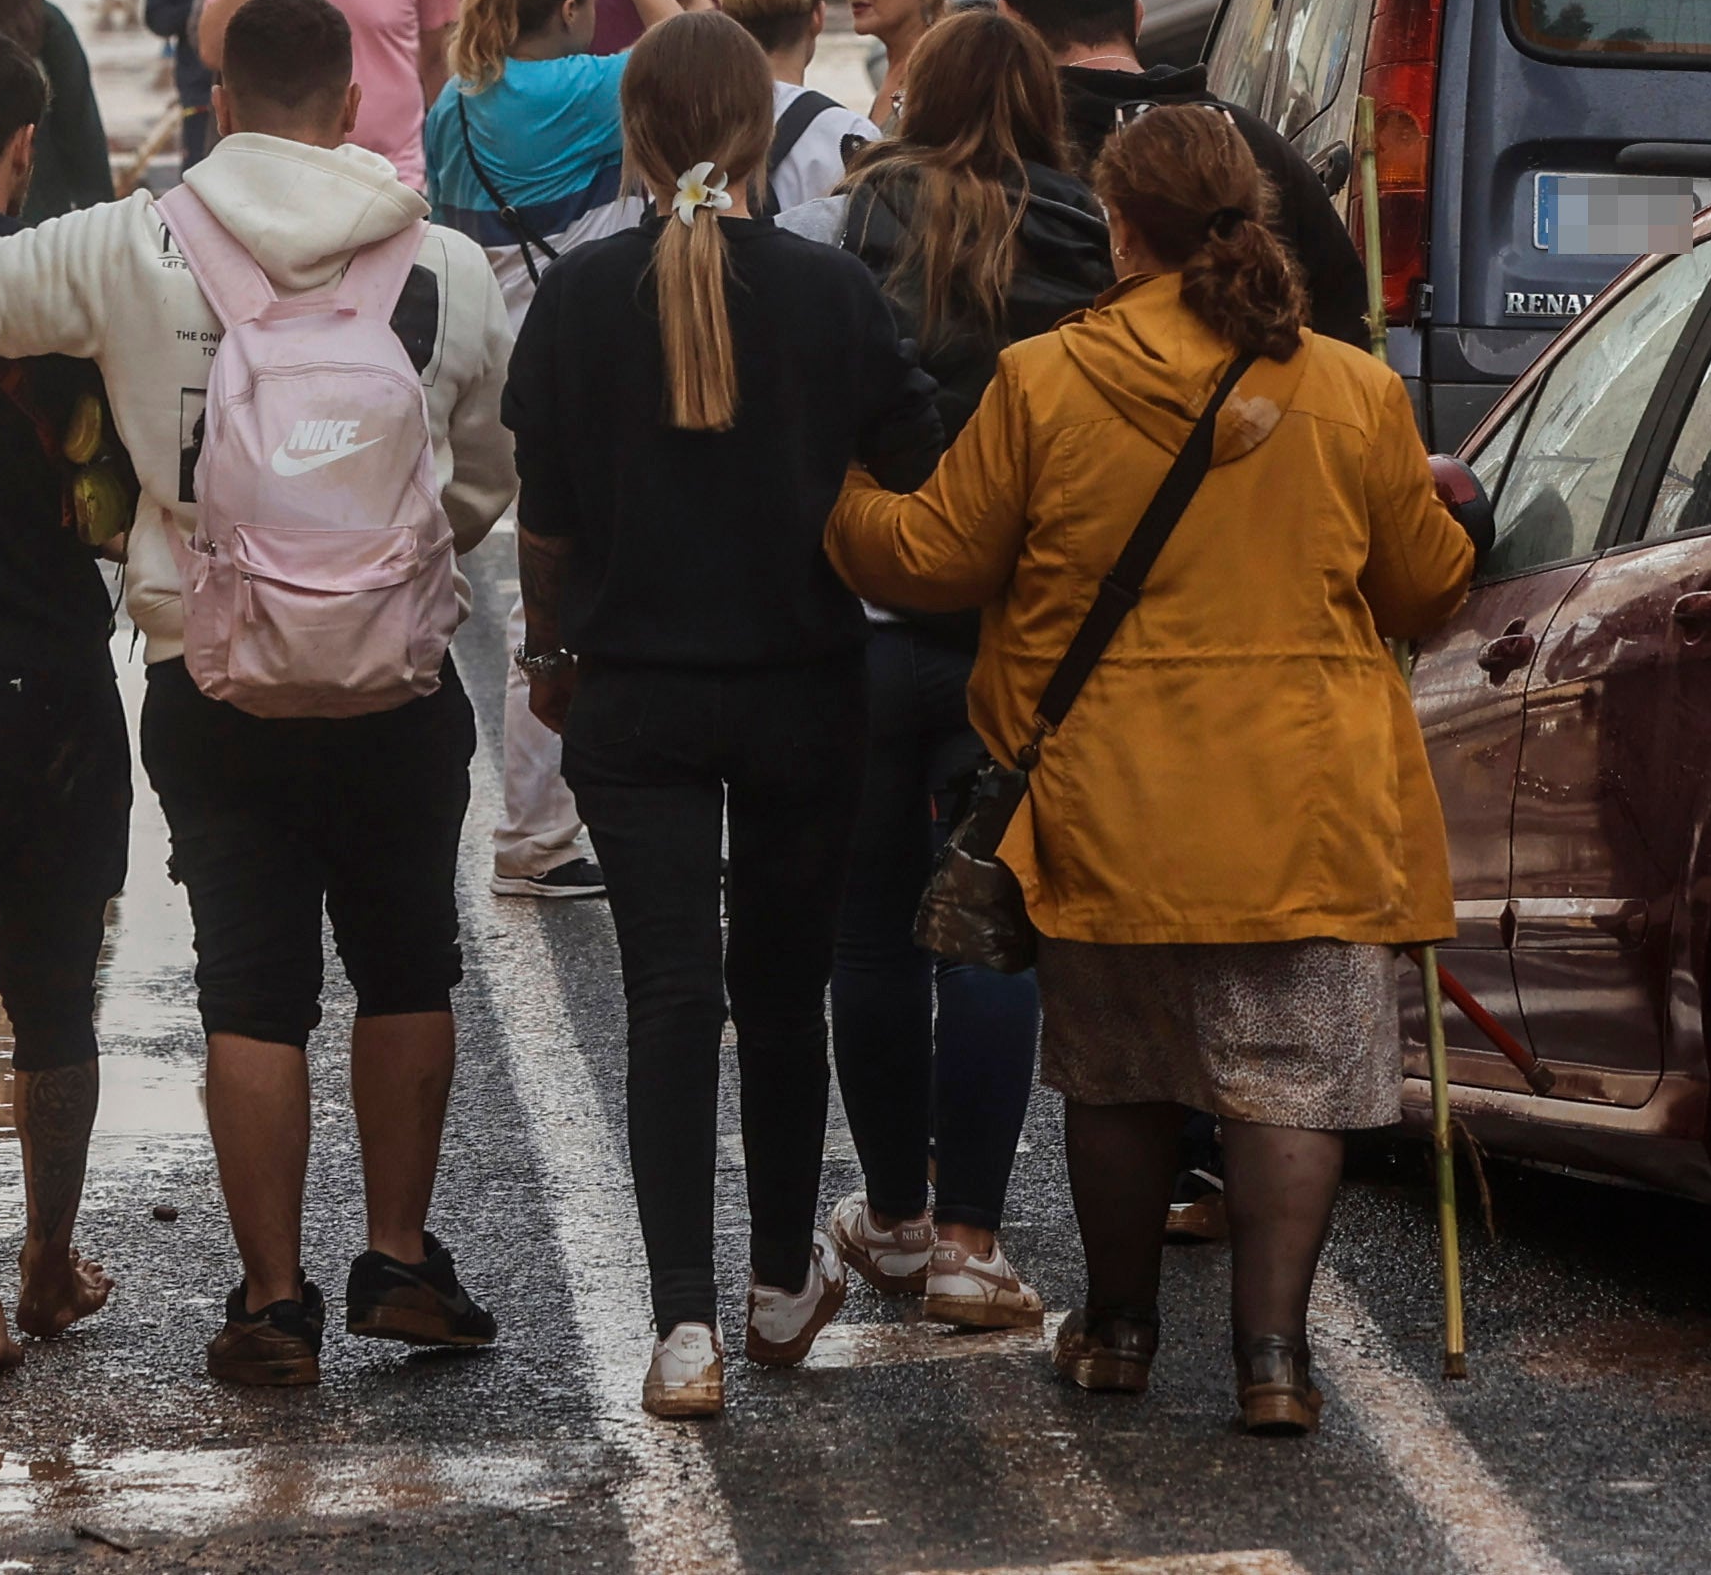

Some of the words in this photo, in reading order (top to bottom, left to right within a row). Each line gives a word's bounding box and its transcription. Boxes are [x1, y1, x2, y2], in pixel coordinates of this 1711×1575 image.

[175, 330, 198, 341] THE
[202, 347, 217, 357] TO
[286, 420, 361, 451] NIKE
[902, 1229, 926, 1241] NIKE
[934, 1250, 958, 1261] NIKE
